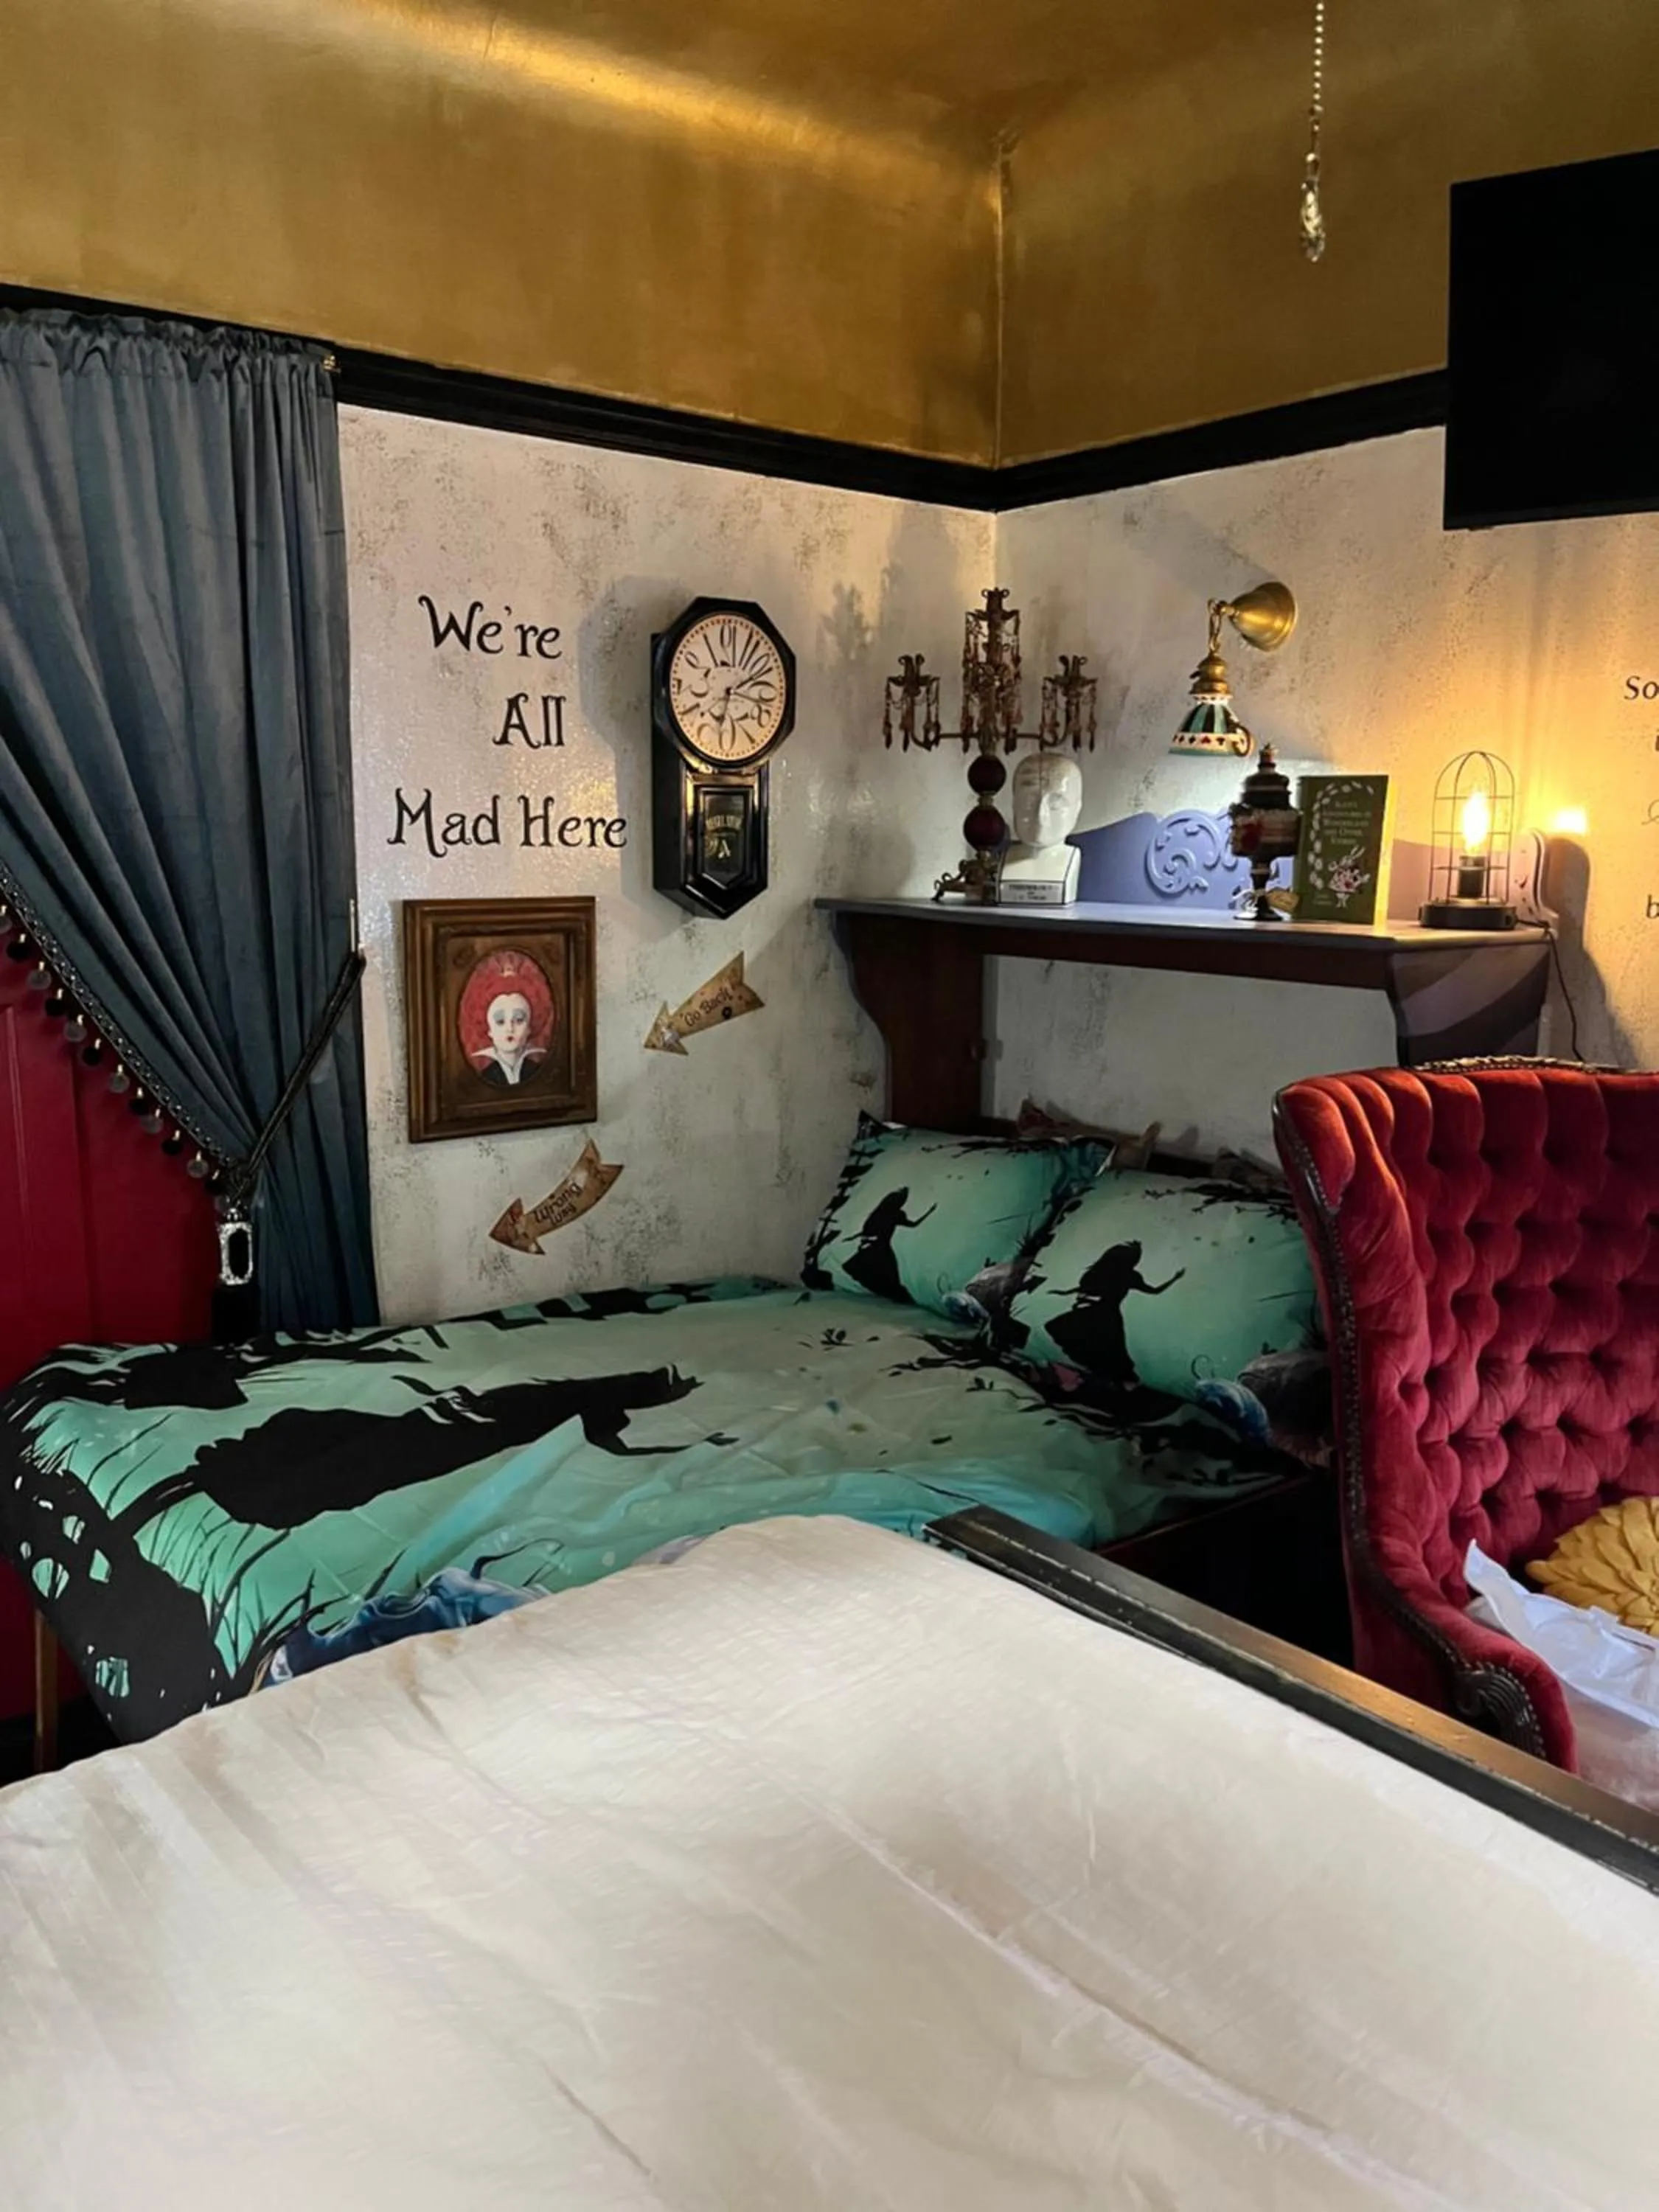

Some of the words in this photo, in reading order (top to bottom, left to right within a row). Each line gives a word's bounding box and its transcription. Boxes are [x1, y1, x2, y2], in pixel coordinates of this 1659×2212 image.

[417, 595, 563, 660] We're
[1624, 675, 1659, 700] So
[493, 692, 566, 750] All
[387, 787, 501, 858] Mad
[517, 795, 627, 848] Here
